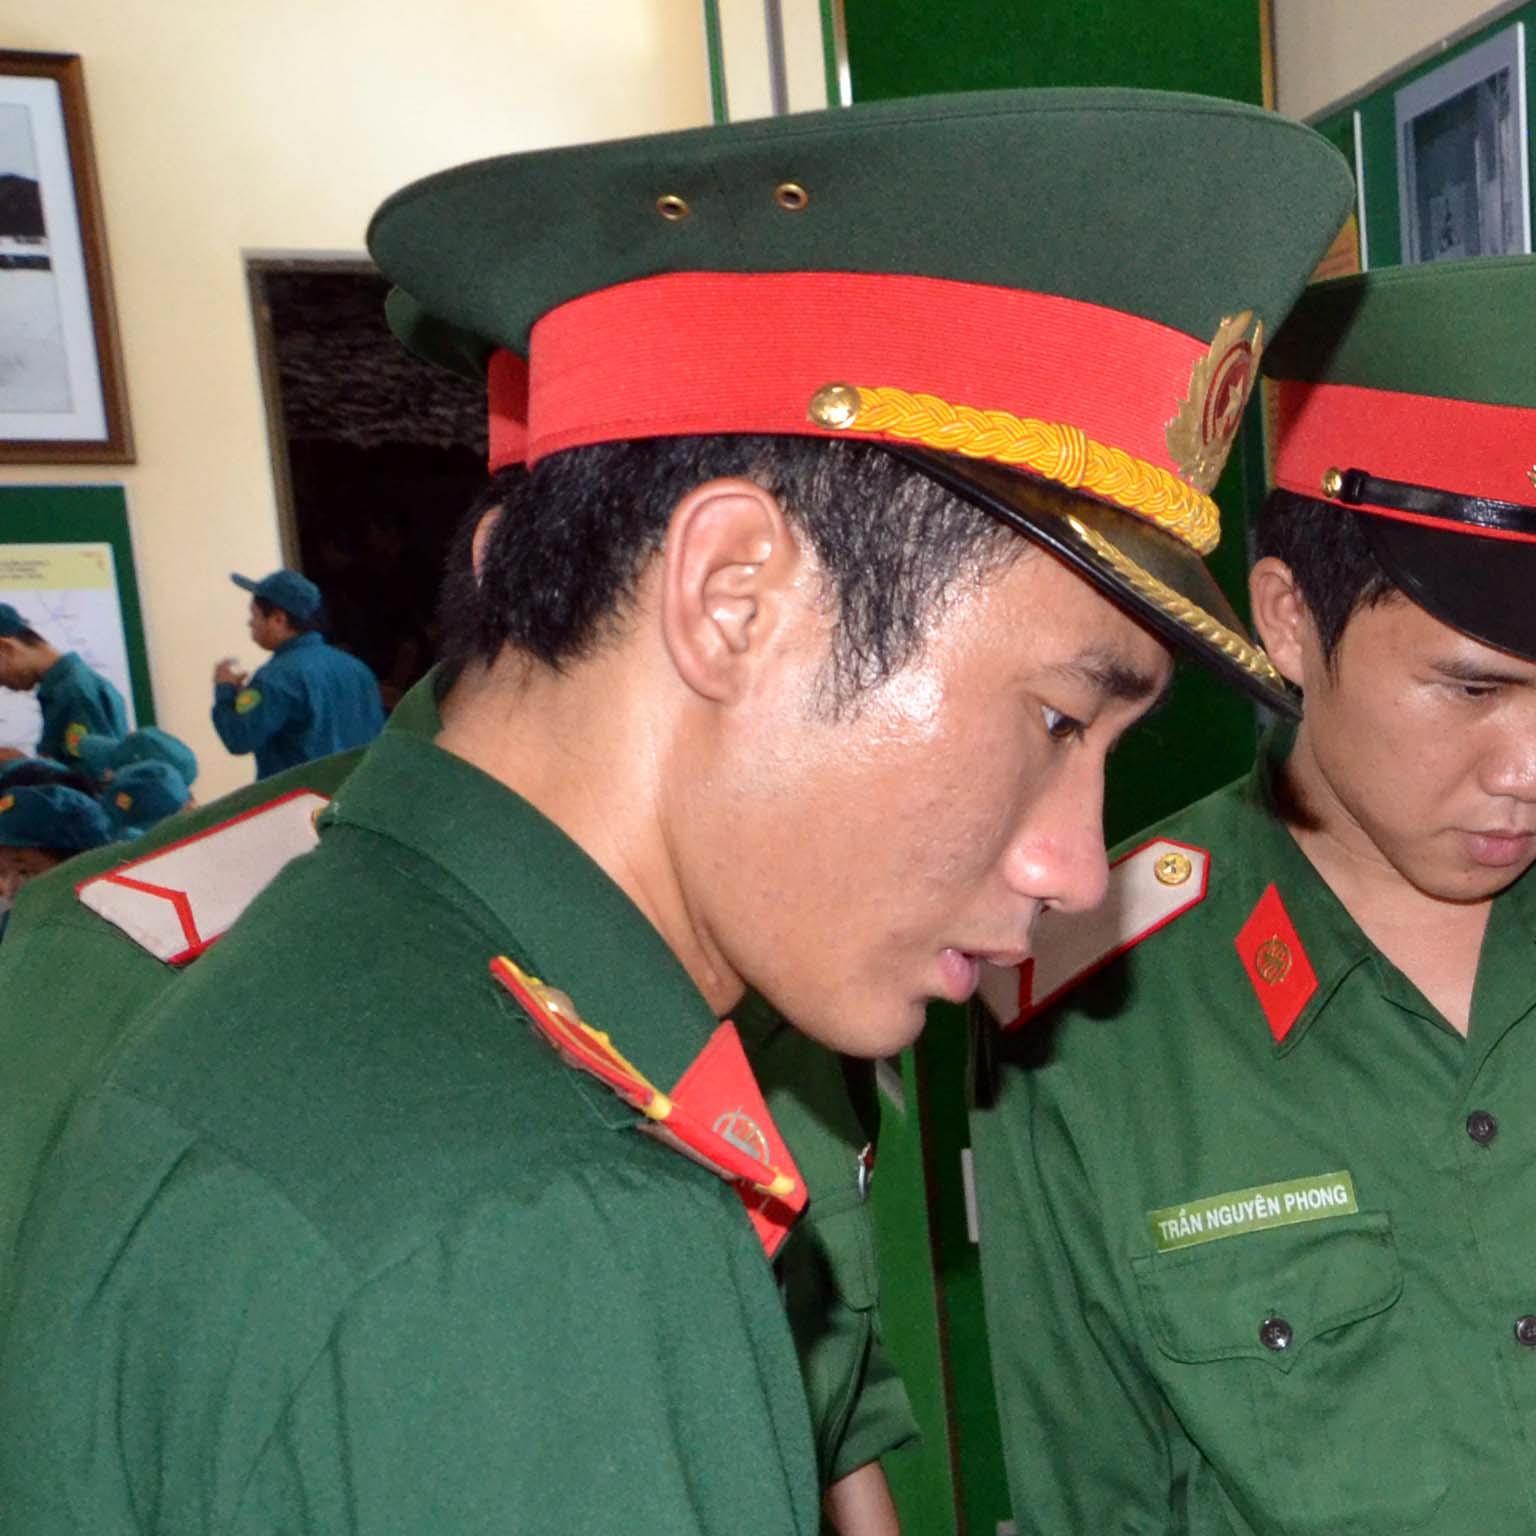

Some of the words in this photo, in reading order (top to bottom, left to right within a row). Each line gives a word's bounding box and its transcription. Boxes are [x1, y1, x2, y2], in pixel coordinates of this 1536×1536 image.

[1157, 1208, 1203, 1241] TRẦN
[1206, 1193, 1281, 1229] NGUYÊN
[1285, 1184, 1348, 1213] PHONG
